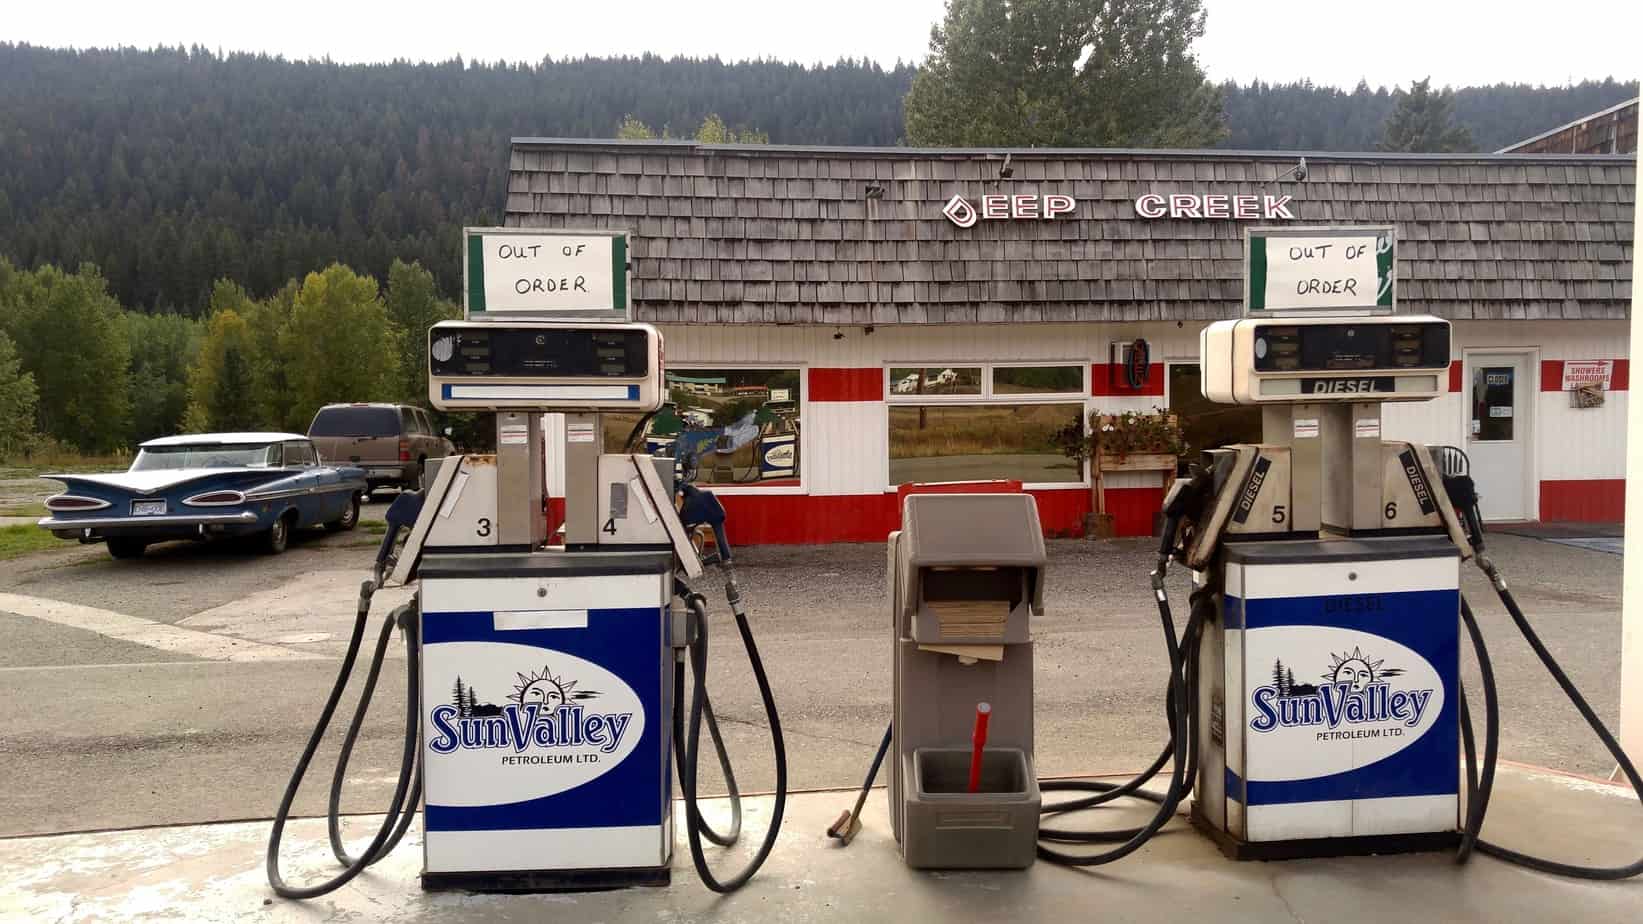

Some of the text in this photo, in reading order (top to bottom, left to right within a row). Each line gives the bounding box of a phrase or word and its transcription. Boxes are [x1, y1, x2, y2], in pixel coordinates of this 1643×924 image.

[942, 193, 1295, 228] DEEP CREEK
[498, 244, 586, 260] OUT OF
[1289, 244, 1368, 261] OUT OF
[1296, 277, 1358, 297] ORDER
[1313, 379, 1381, 394] DIESEL
[1240, 469, 1265, 512] DIESEL
[1405, 464, 1430, 505] DIESEL
[1271, 505, 1286, 524] 5
[1384, 502, 1397, 520] 6
[476, 518, 491, 538] 3
[602, 518, 617, 535] 4
[1250, 680, 1433, 733] SunValley
[429, 701, 632, 755] SunValley
[1316, 727, 1406, 742] PETROLEUM LTD.
[501, 753, 601, 766] PETROLEUM LTD.
